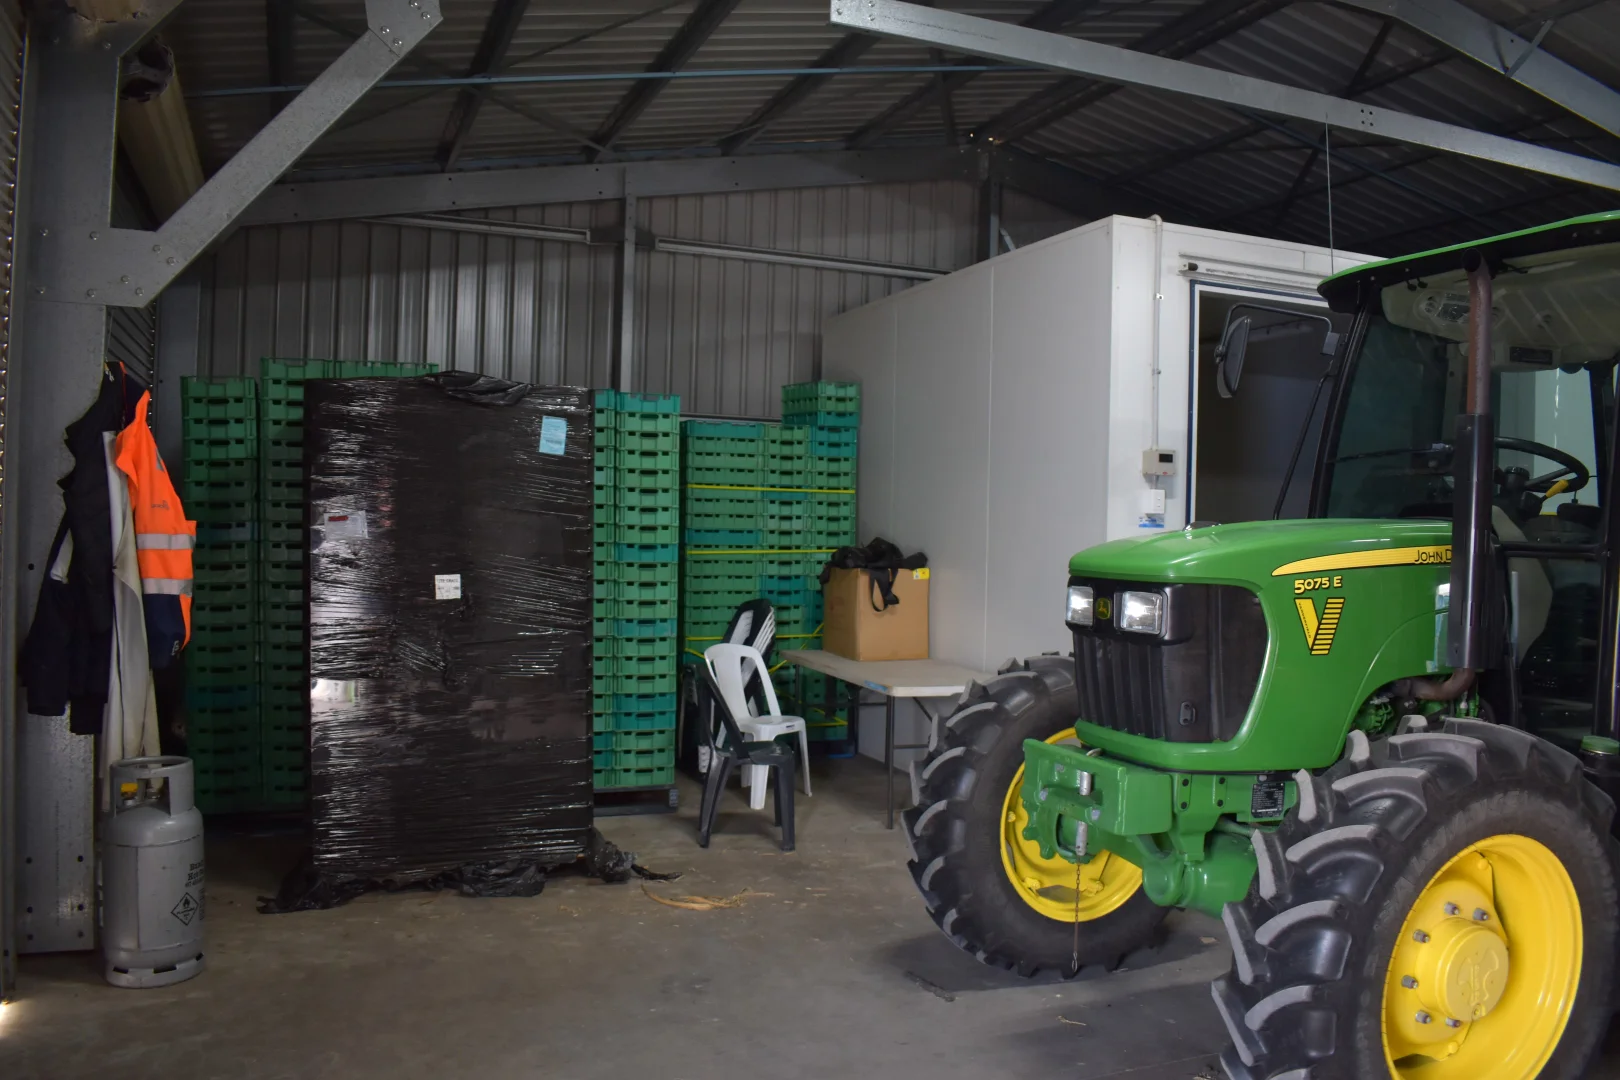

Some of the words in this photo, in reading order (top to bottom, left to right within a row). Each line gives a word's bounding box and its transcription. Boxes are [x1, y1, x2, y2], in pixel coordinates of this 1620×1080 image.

[1414, 549, 1443, 562] JOHN
[1294, 577, 1330, 594] 5075
[1333, 575, 1343, 588] E
